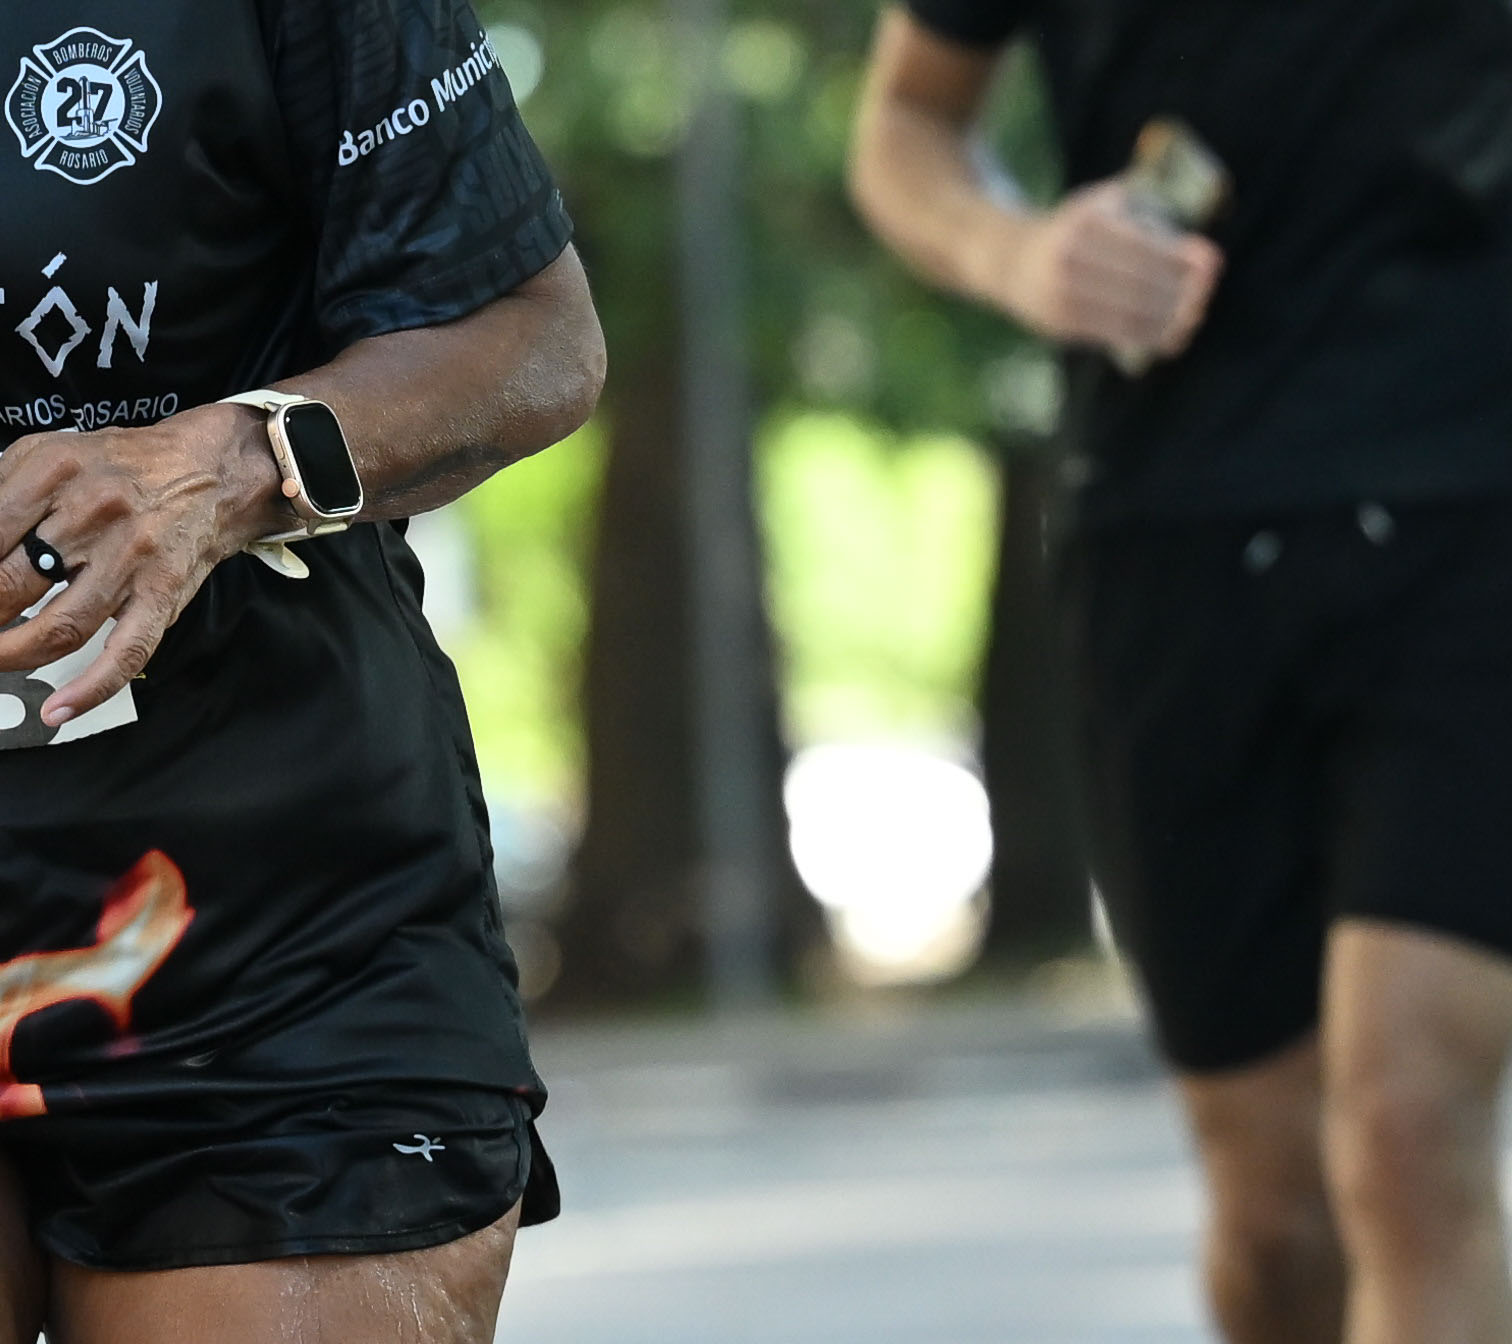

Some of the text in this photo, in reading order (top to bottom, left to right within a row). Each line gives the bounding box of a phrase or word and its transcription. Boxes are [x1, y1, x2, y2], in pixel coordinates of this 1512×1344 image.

[53, 43, 112, 65] BOMBEROS
[20, 74, 42, 139] ASOCIACIÓN
[56, 77, 113, 128] 27
[124, 68, 145, 134] VOLUNTARIOS
[338, 99, 430, 166] Banco
[59, 149, 108, 169] ROSARIO
[70, 393, 179, 432] ROSARIO
